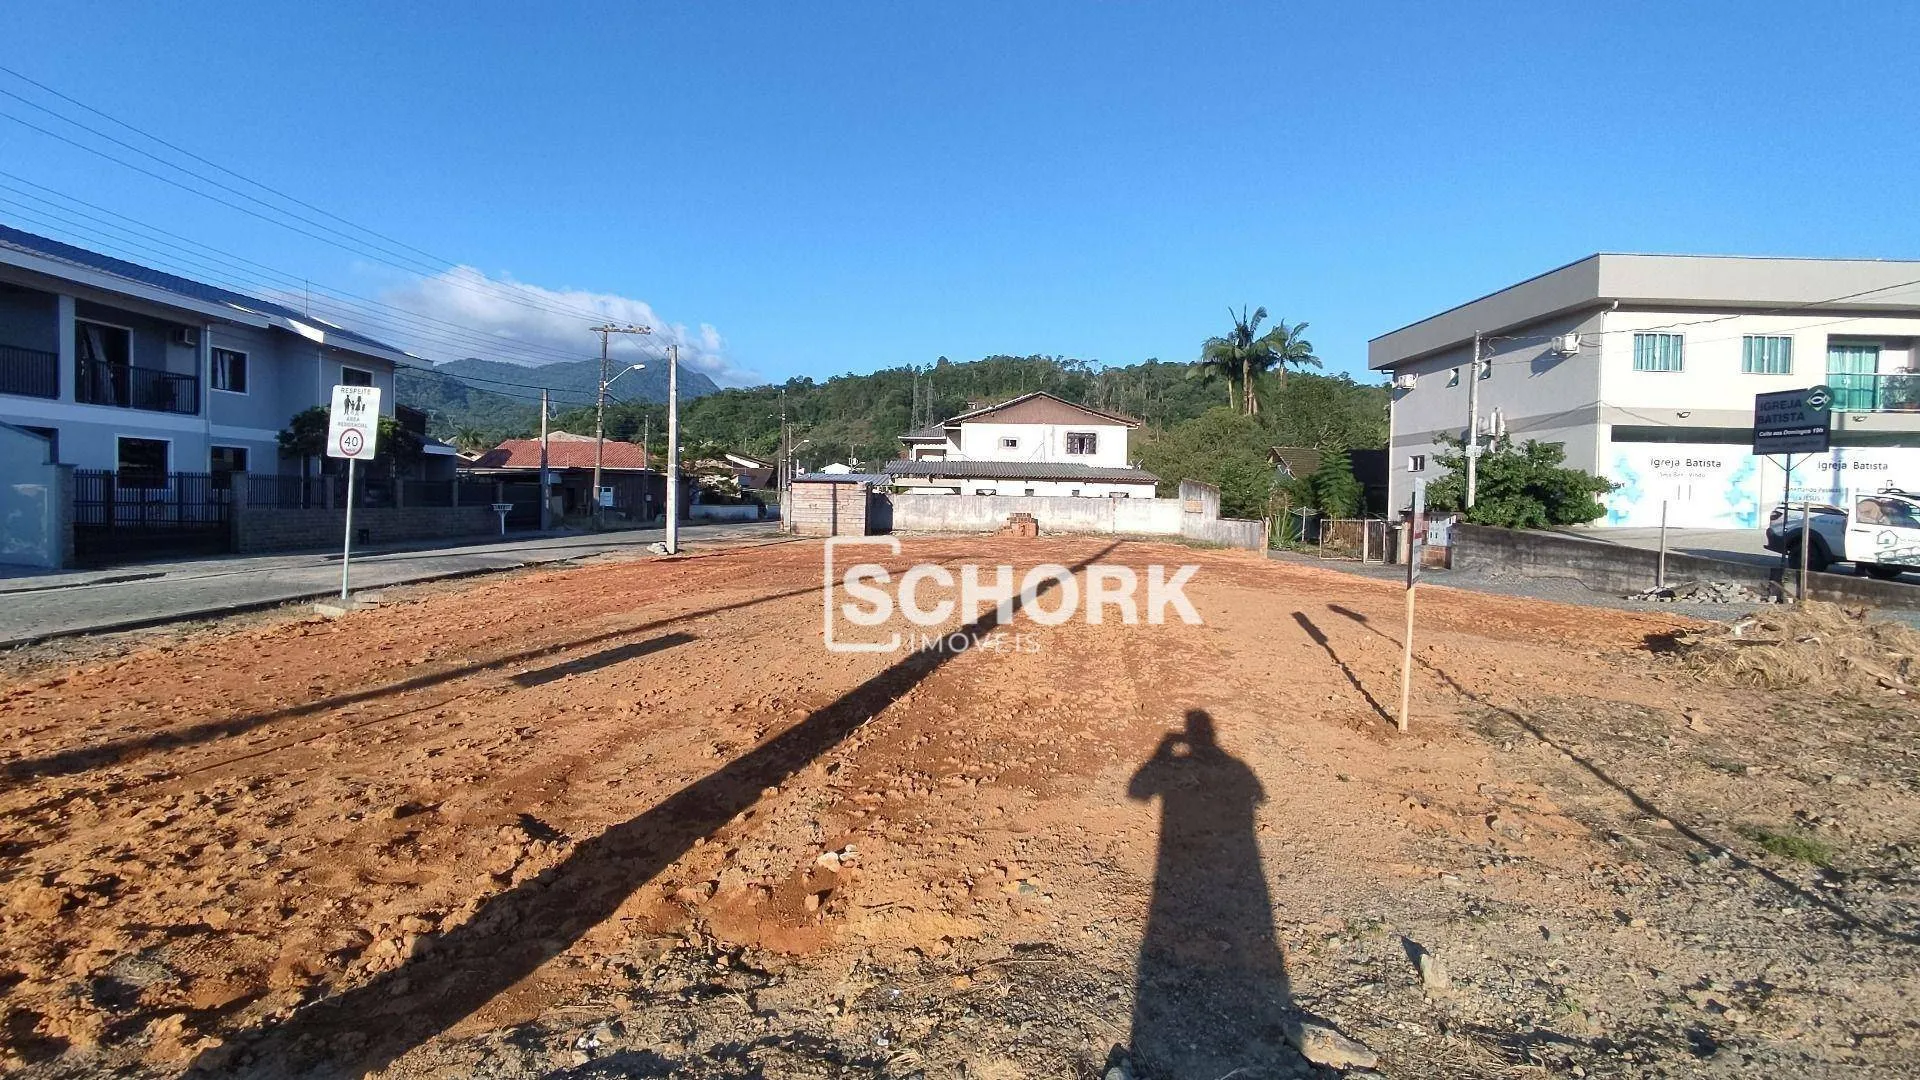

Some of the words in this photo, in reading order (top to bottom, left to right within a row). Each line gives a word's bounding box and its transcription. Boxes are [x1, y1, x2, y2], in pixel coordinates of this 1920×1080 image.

[340, 387, 371, 396] RESPEITE
[1760, 400, 1802, 412] IGREJA
[1758, 412, 1805, 424] BATISTA
[344, 436, 359, 447] 40
[1650, 458, 1680, 468] Igreja
[1686, 458, 1721, 468] Batista
[1818, 460, 1847, 471] Igreja
[1853, 461, 1888, 470] Batista
